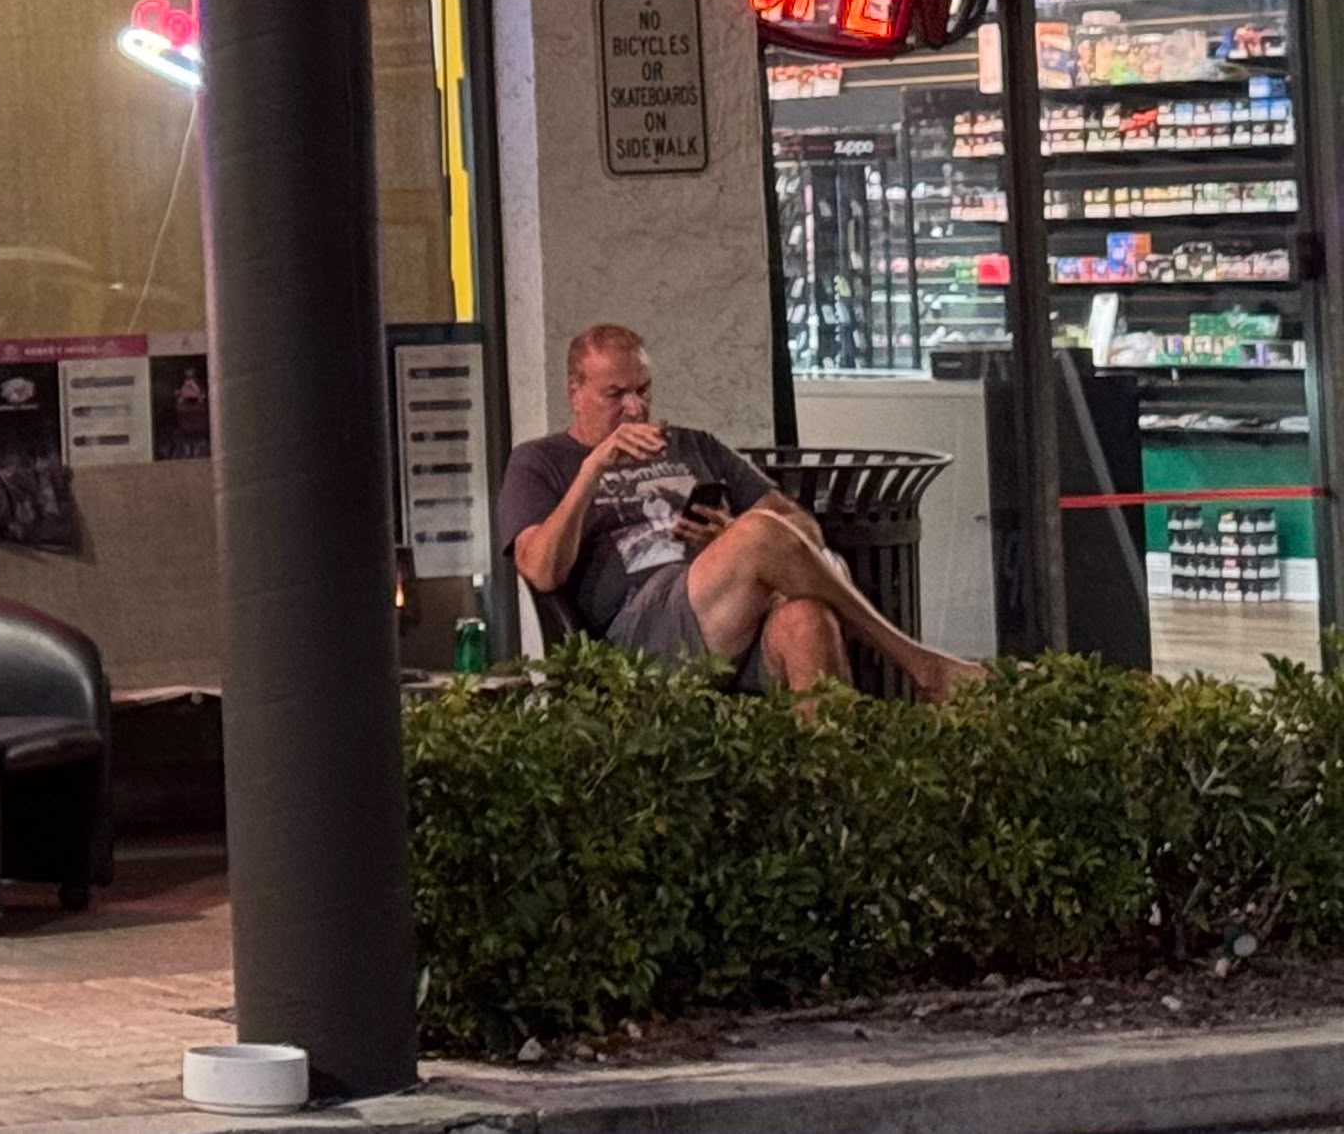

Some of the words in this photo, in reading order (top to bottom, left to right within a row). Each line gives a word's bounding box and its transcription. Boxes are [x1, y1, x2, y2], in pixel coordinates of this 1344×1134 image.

[638, 9, 661, 31] NO
[612, 34, 690, 57] BICYCLES
[641, 60, 664, 82] OR
[610, 83, 698, 108] SKATEBOARDS
[644, 111, 667, 133] ON
[615, 136, 698, 159] SIDEWALK
